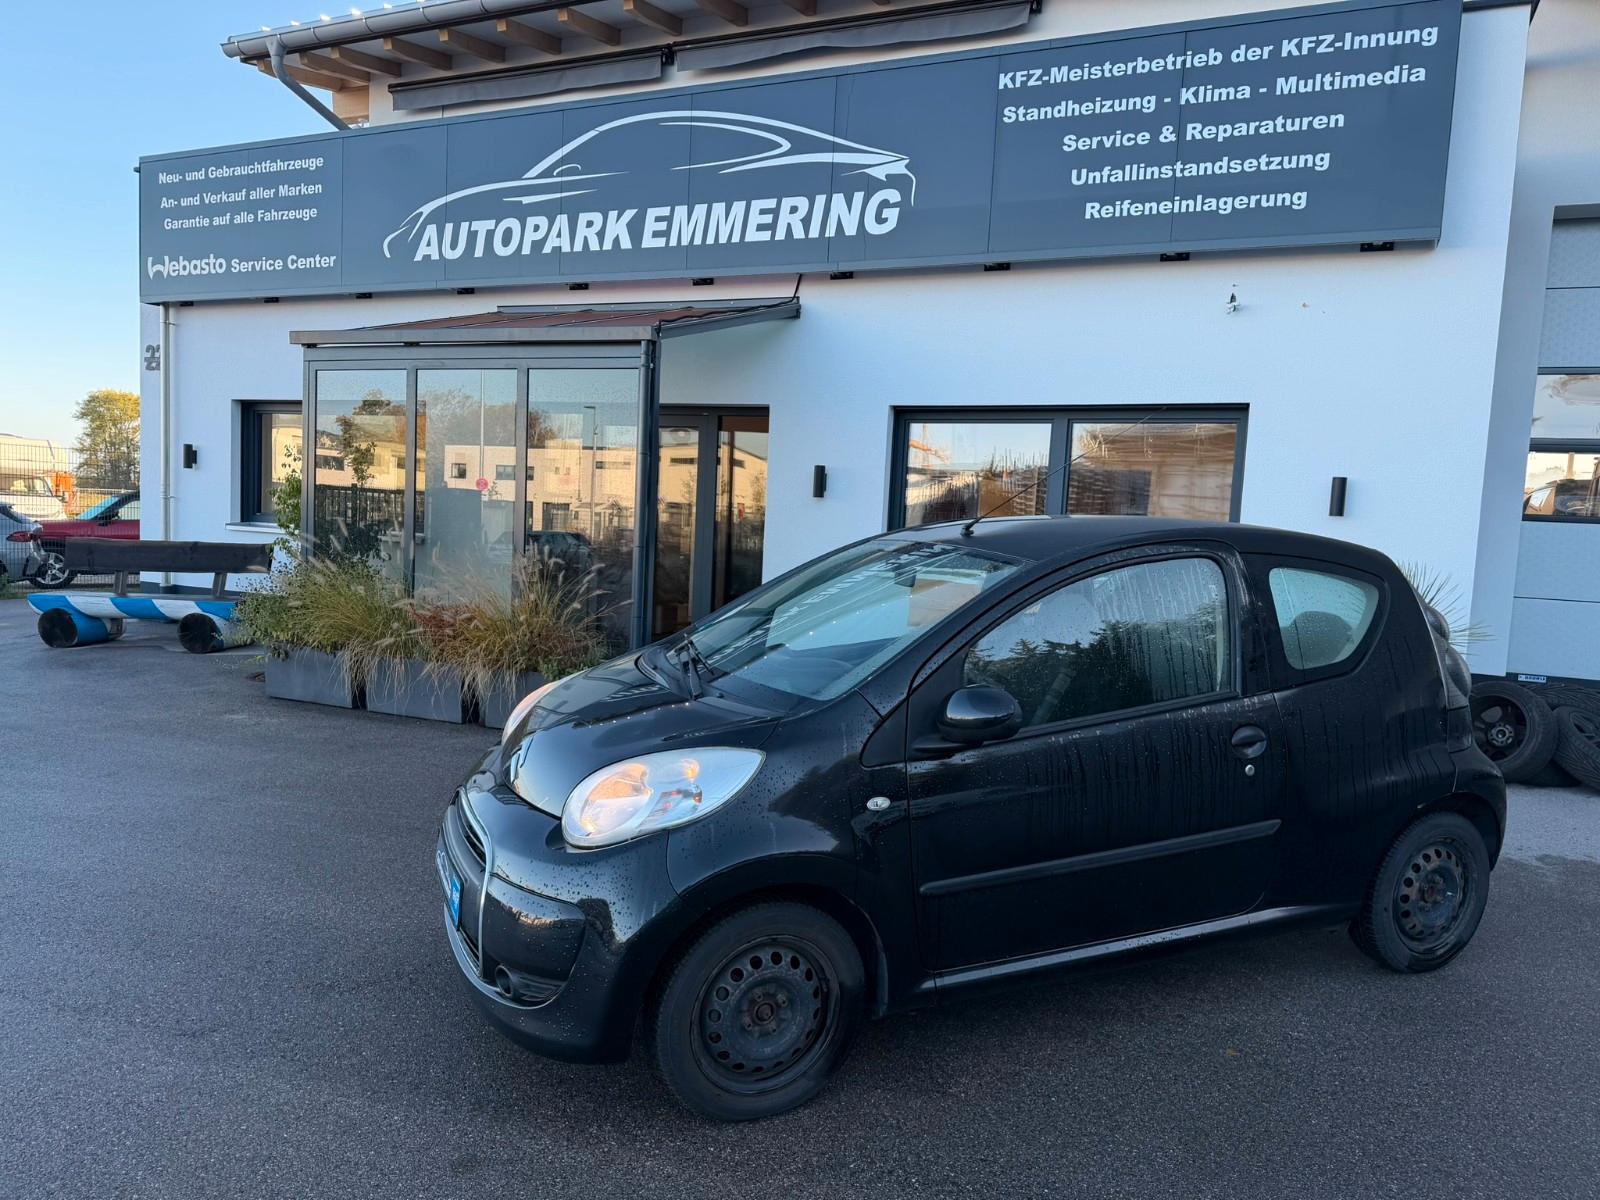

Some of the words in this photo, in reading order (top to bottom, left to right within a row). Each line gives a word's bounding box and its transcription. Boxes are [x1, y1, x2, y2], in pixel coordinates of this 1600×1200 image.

[998, 50, 1223, 90] KFZ-Meisterbetrieb
[1230, 42, 1273, 64] der
[1281, 24, 1439, 58] KFZ-Innung
[1002, 91, 1156, 124] Standheizung
[1179, 83, 1251, 105] Klima
[1275, 64, 1427, 96] Multimedia
[1062, 129, 1151, 152] Service
[1158, 124, 1177, 143] &
[1186, 112, 1346, 142] Reparaturen
[158, 172, 183, 185] Neu-
[185, 168, 205, 181] und
[208, 156, 324, 178] Gebrauchtfahrzeuge
[1071, 150, 1331, 186] Unfallinstandsetzung
[160, 196, 178, 209] An-
[180, 194, 200, 206] und
[203, 188, 246, 204] Verkauf
[249, 187, 275, 200] aller
[278, 182, 323, 197] Marken
[1084, 189, 1308, 220] Reifeneinlagerung
[163, 215, 210, 230] Garantie
[212, 212, 231, 226] auf
[233, 210, 254, 224] alle
[257, 207, 318, 223] Fahrzeuge
[413, 208, 637, 262] AUTOPARK
[641, 188, 902, 250] EMMERING
[147, 253, 226, 280] Webasto
[230, 256, 284, 273] Service
[287, 253, 337, 270] Center
